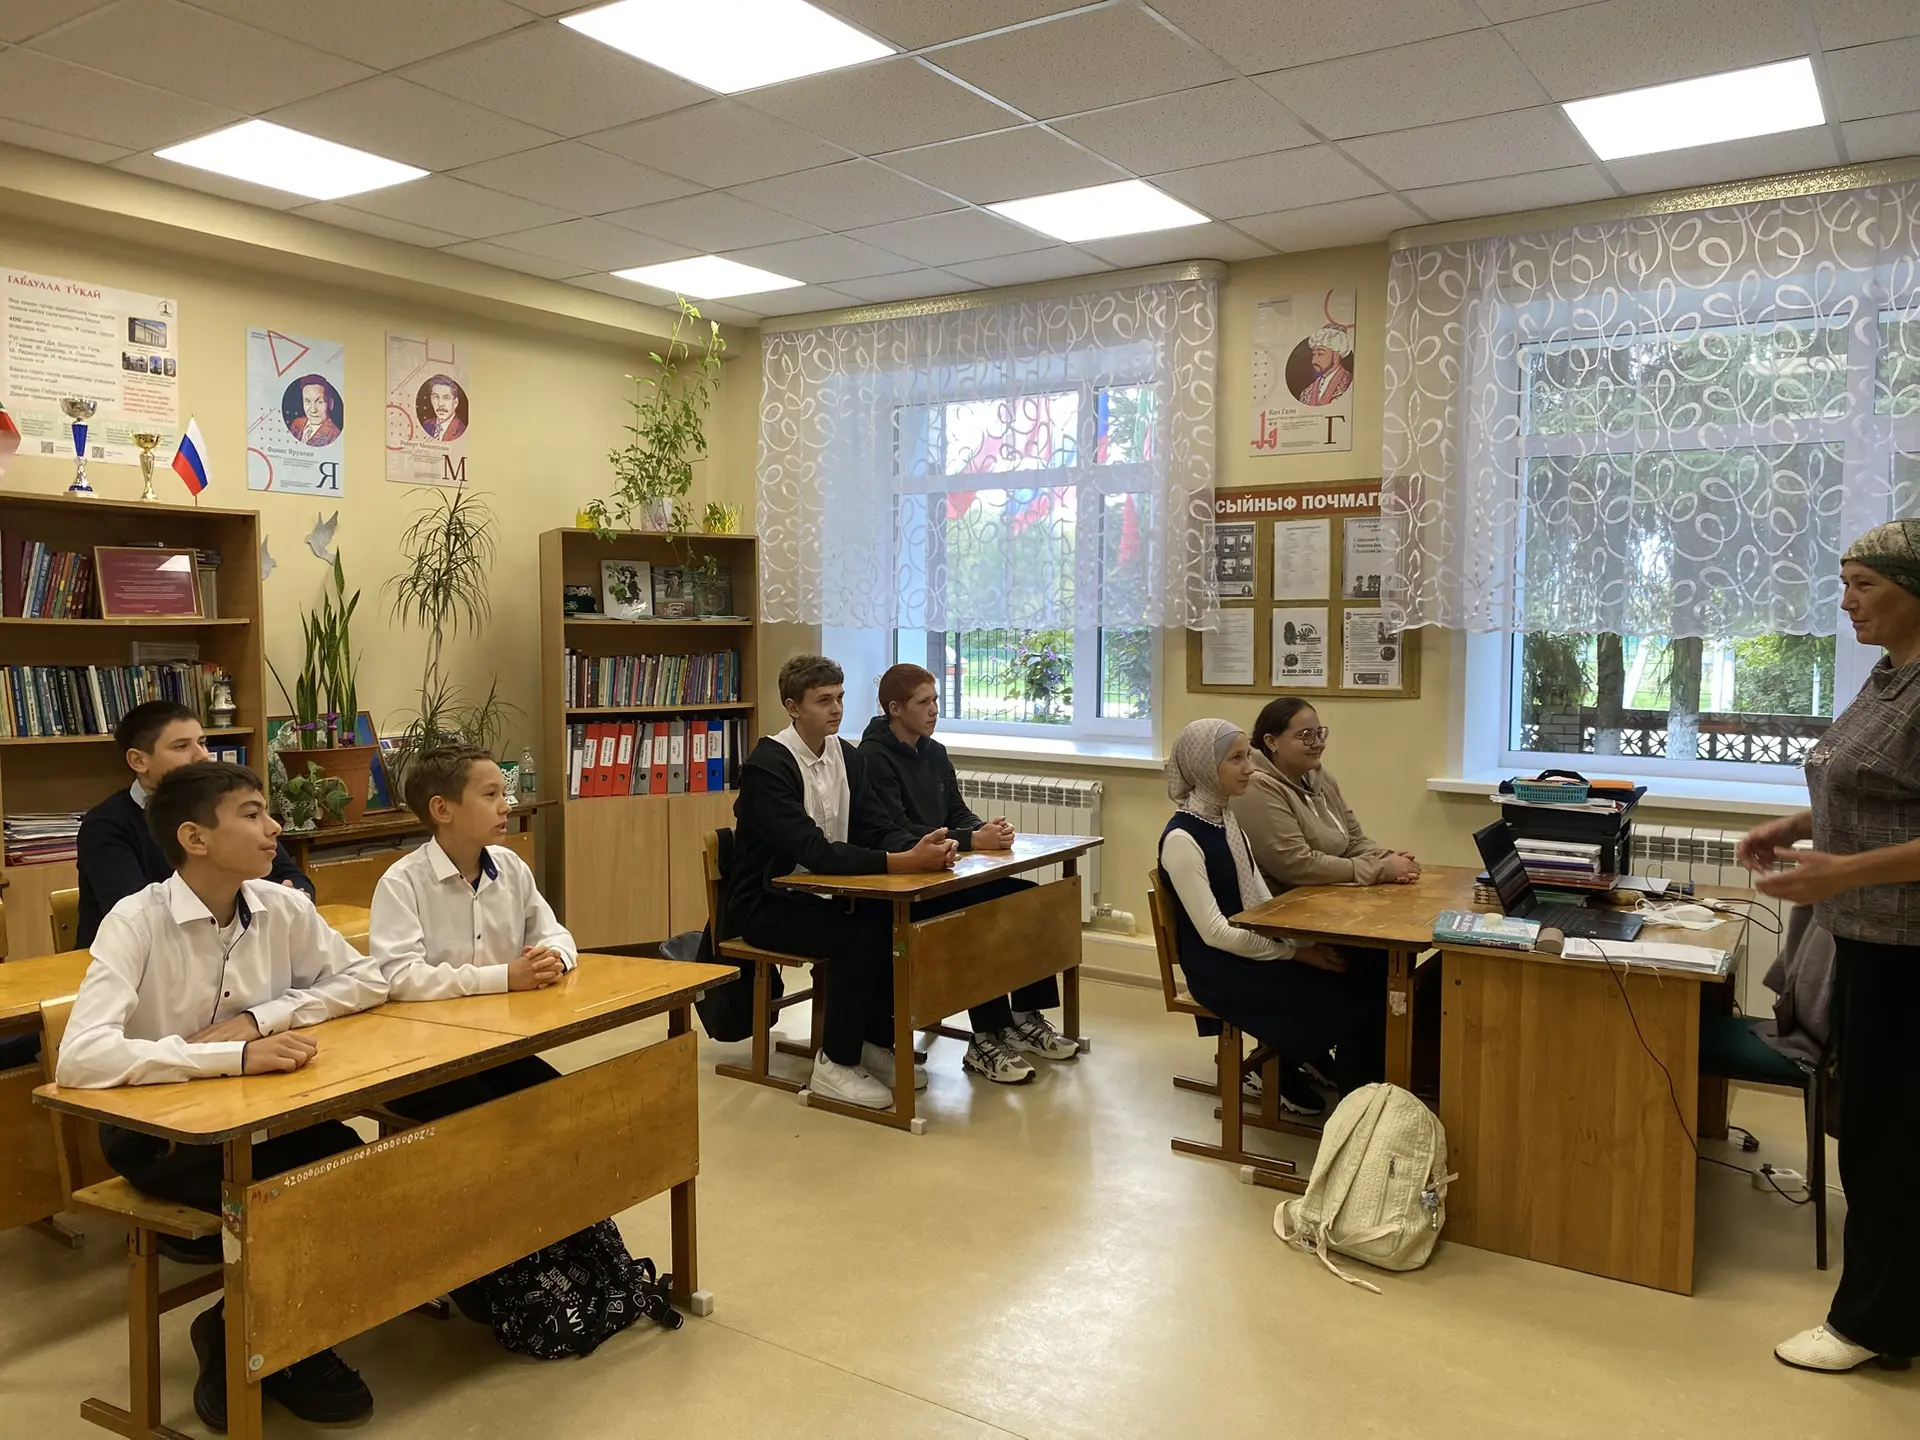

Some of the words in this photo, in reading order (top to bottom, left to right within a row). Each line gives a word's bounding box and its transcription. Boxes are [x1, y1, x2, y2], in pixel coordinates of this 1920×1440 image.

[8, 275, 60, 292] ГАБДУЛЛА
[65, 284, 101, 299] ТУКАЙ
[1324, 415, 1345, 445] Г
[316, 461, 339, 490] Я
[442, 454, 468, 482] М
[1215, 494, 1297, 513] СЫЙНЫФ
